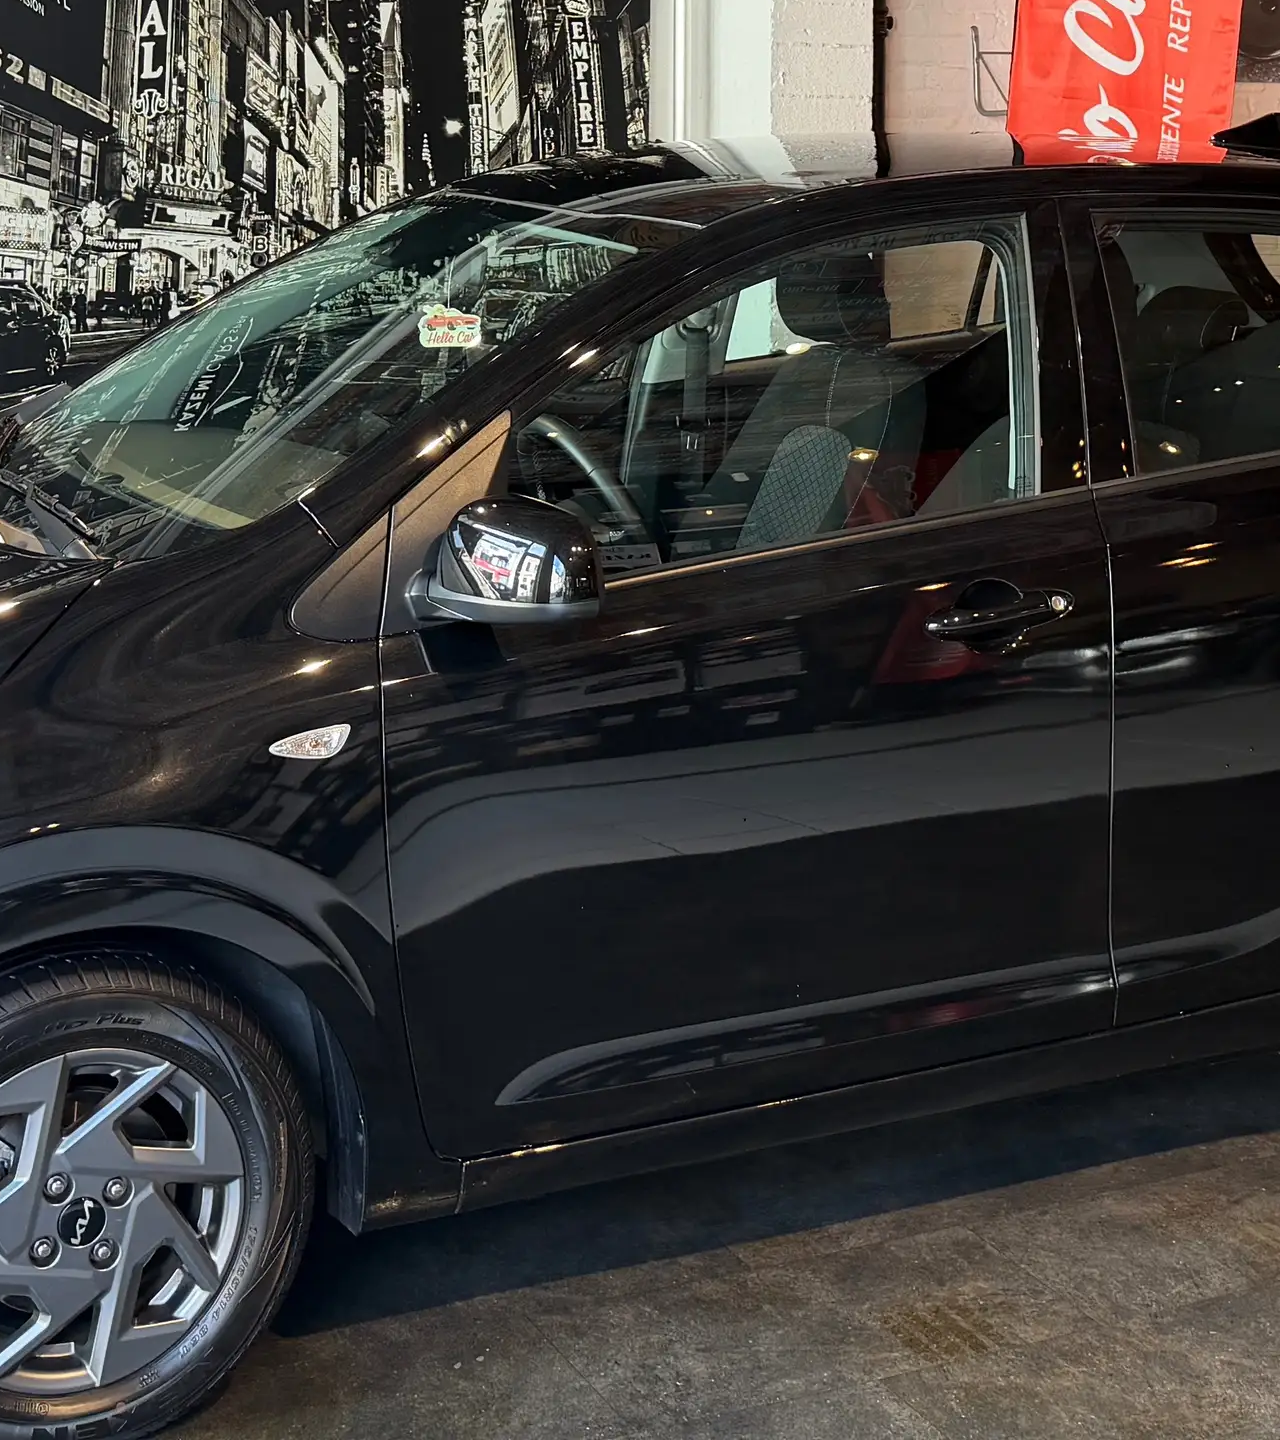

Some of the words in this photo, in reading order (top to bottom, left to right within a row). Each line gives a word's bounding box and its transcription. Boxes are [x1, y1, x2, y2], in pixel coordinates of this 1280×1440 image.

[570, 21, 596, 144] EMPIRE
[427, 331, 454, 344] Hello
[457, 331, 474, 343] Car
